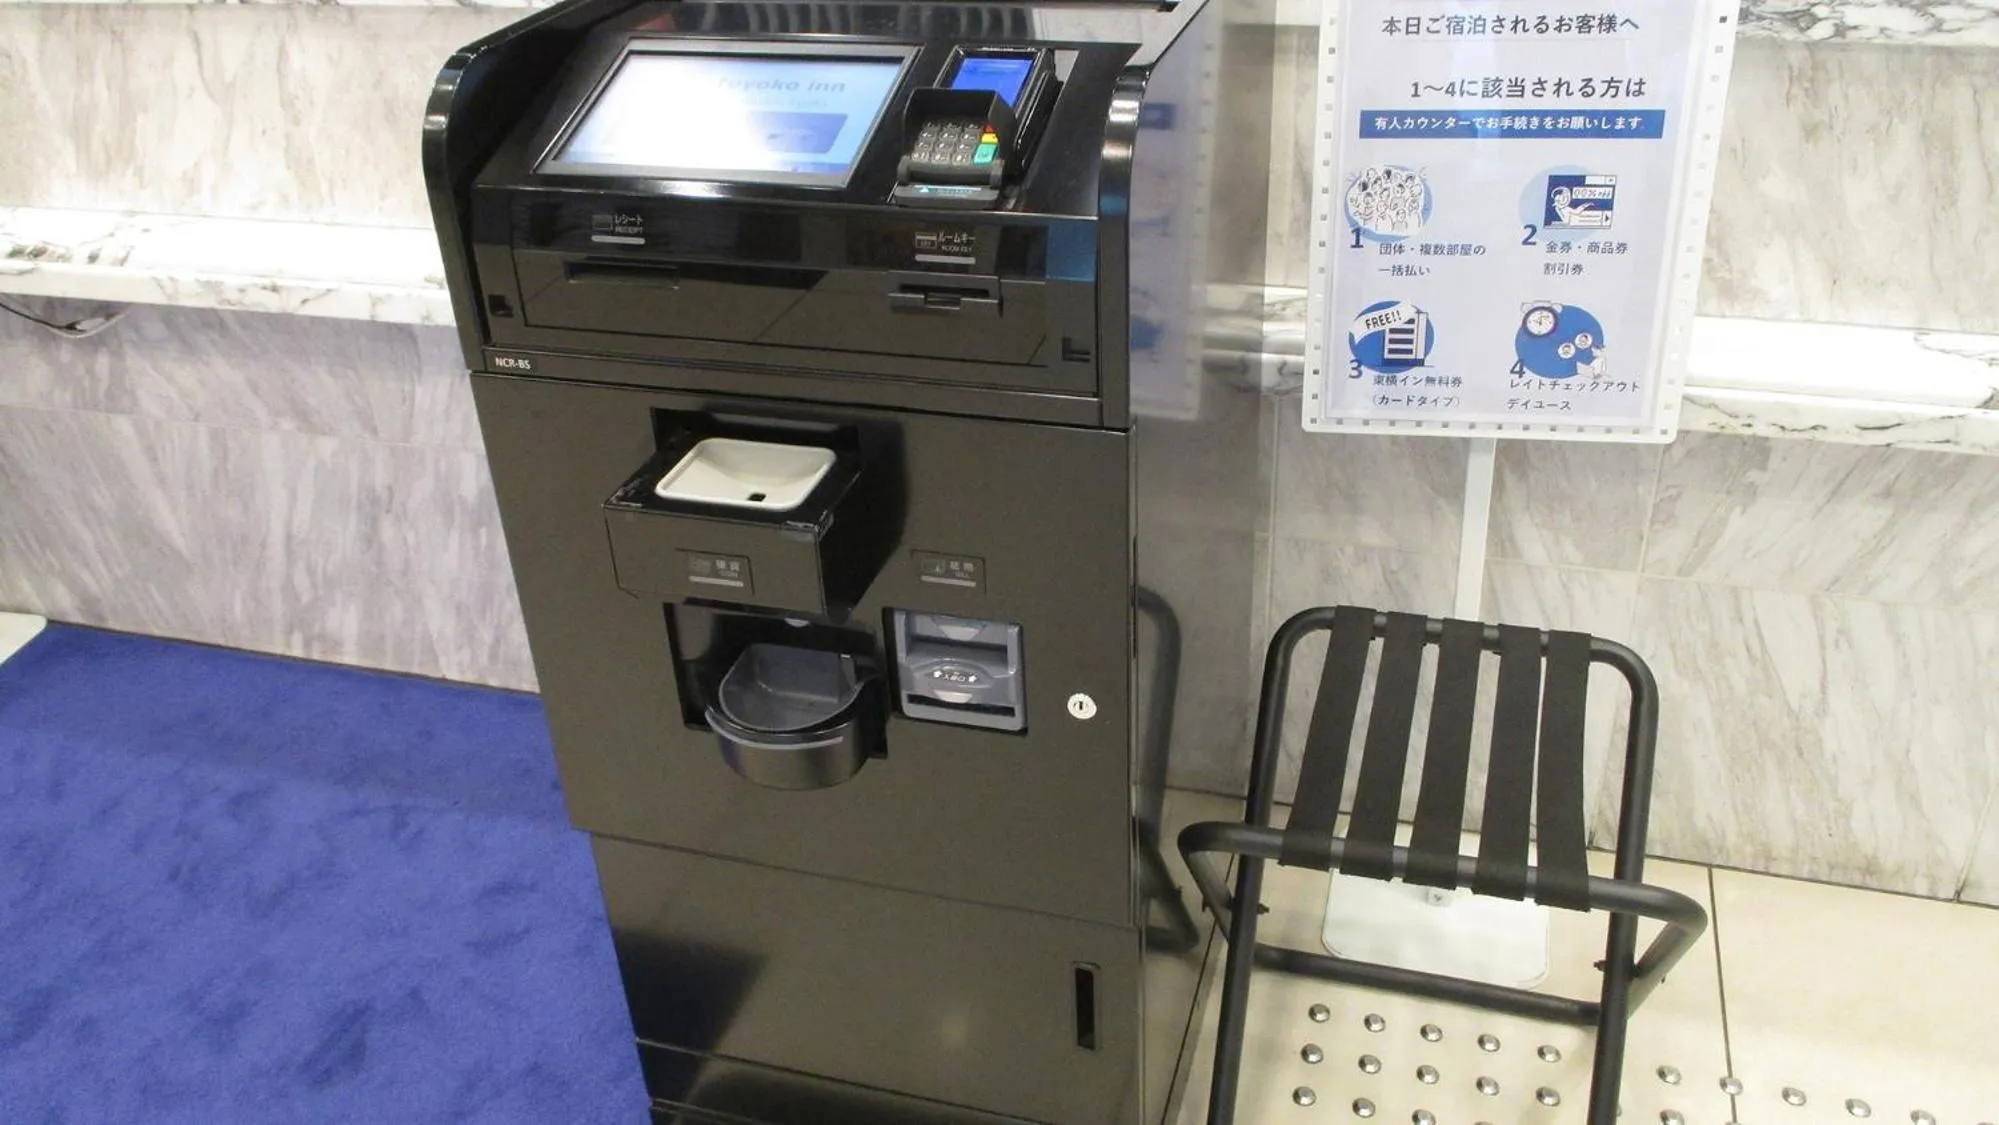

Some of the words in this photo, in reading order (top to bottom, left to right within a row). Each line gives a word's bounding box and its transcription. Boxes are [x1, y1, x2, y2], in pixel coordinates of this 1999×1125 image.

[1382, 13, 1640, 36] 本日ご宿泊されるお客様へ
[807, 79, 845, 92] inn
[1350, 227, 1364, 249] 1
[1521, 224, 1537, 246] 2
[1379, 242, 1486, 257] 団体・複数部屋の
[1545, 240, 1628, 255] 金券・商品券
[1377, 264, 1431, 277] 一括払い
[1543, 262, 1584, 276] 割引券
[1365, 309, 1403, 330] FREE!!
[1348, 359, 1363, 379] 3
[1509, 359, 1526, 379] 4
[1373, 374, 1463, 388] 東横イン無料券
[1509, 378, 1641, 393] レイトチェックアウト
